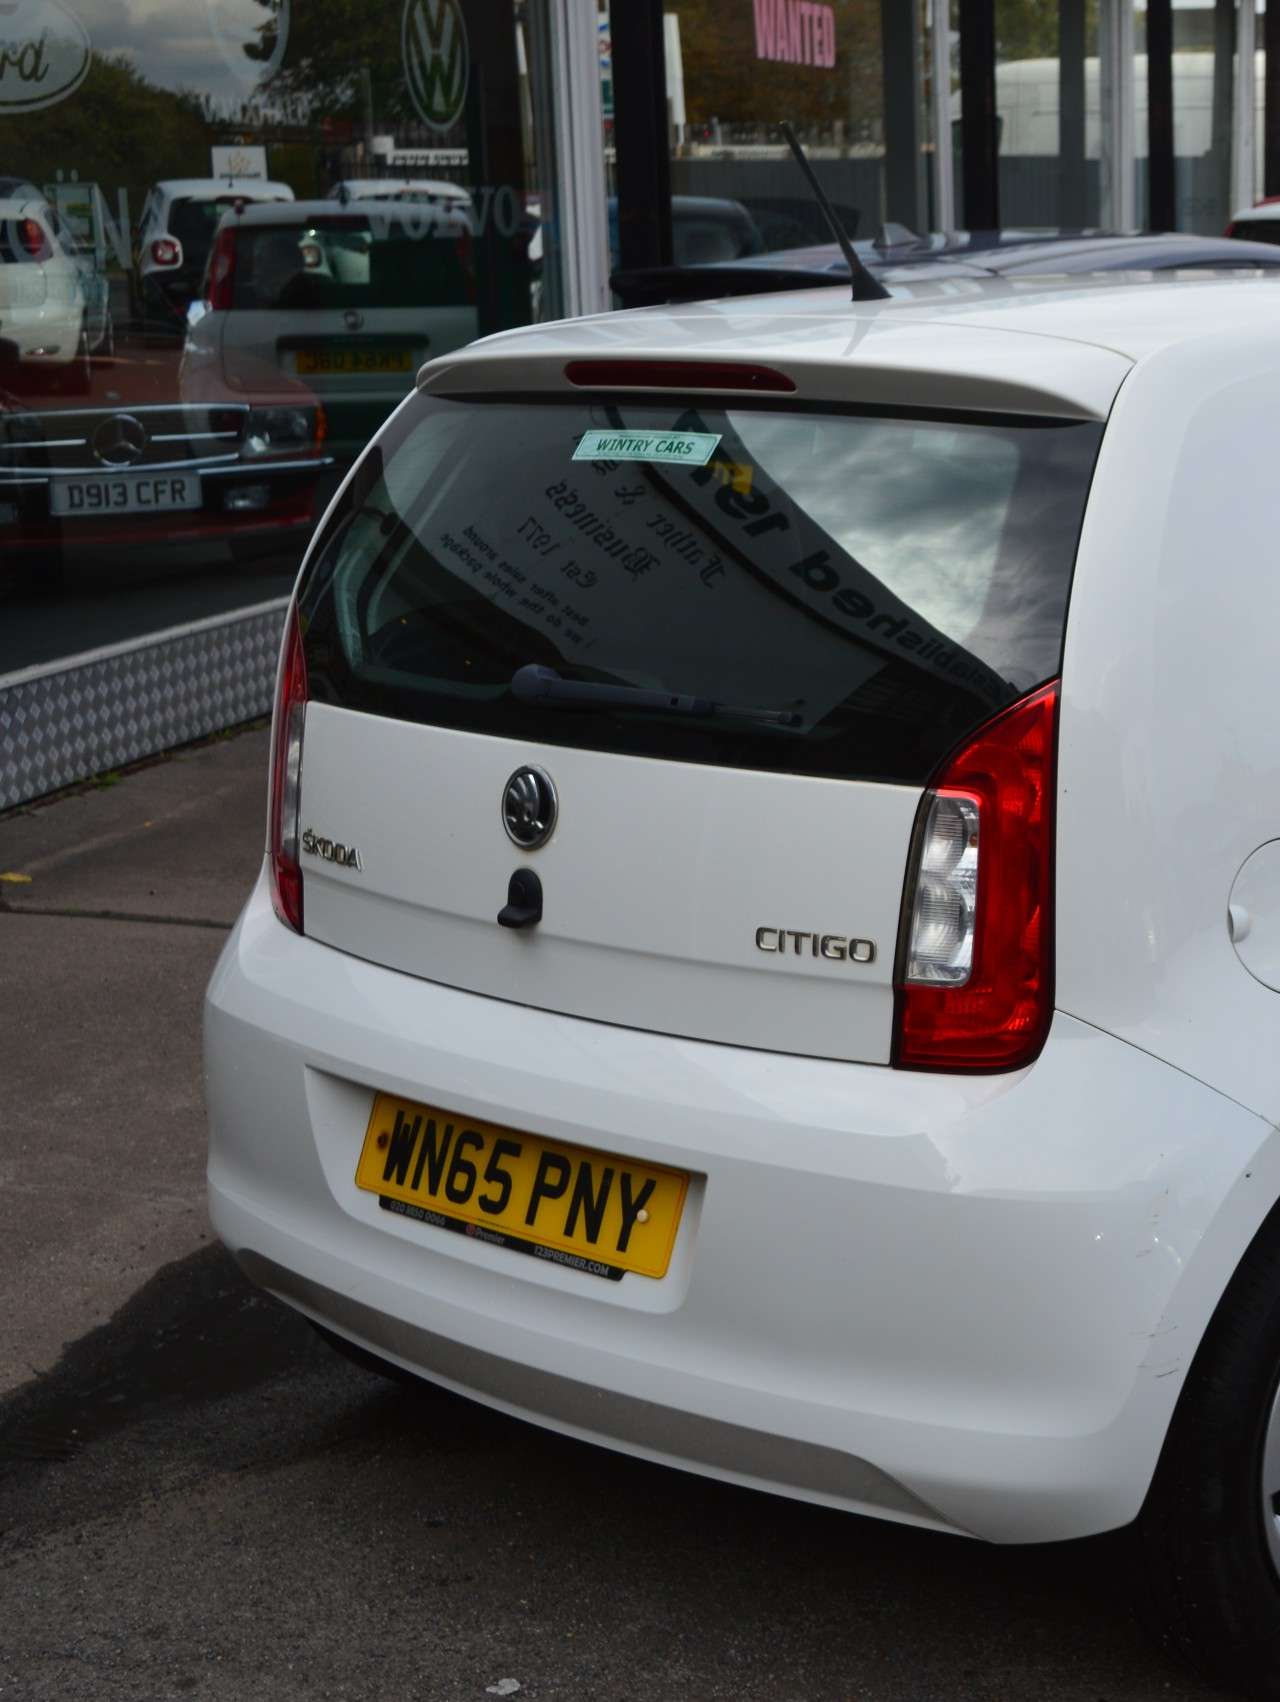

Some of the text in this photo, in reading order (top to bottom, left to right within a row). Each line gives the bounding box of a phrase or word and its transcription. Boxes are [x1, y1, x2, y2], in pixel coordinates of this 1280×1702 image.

[754, 0, 836, 68] WANTED
[368, 185, 521, 240] VOLVO
[596, 438, 695, 455] WINTRY CARS
[67, 478, 187, 509] D913 CFR
[755, 926, 877, 963] CITIGO
[382, 1110, 657, 1253] WN65 PNY
[534, 1245, 610, 1277] 123PREMIER.COM
